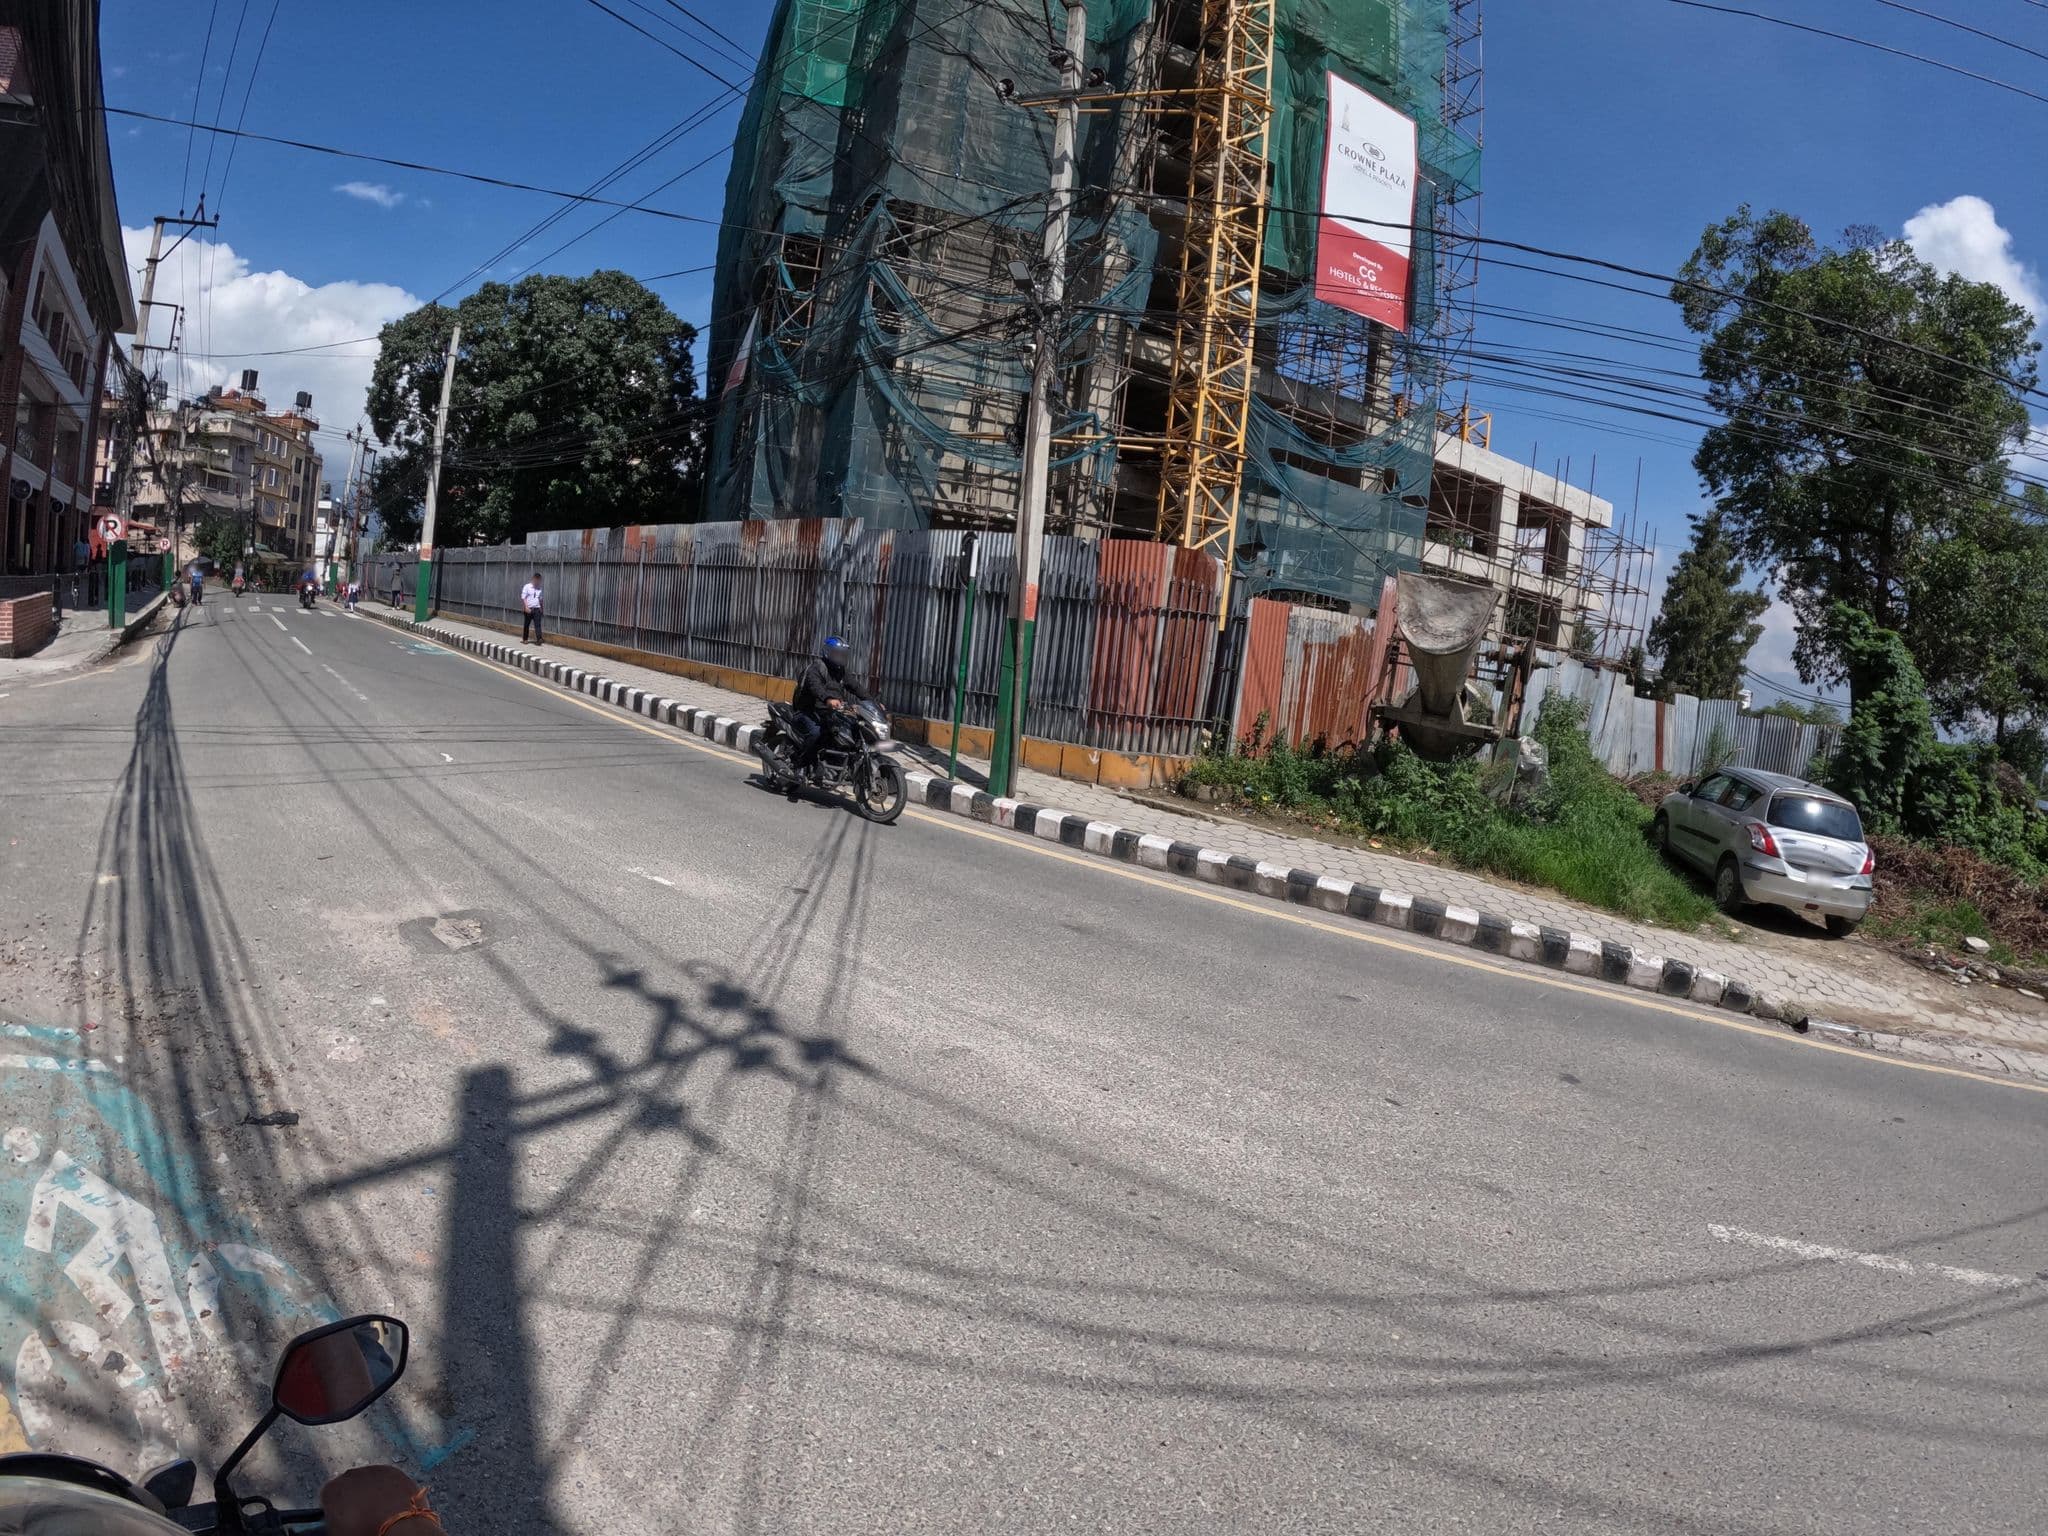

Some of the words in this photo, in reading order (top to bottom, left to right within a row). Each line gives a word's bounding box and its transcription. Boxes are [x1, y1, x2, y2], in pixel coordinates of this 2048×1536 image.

[1337, 143, 1377, 171] CROWNE
[1379, 166, 1407, 189] PLAZA
[1329, 265, 1362, 286] HOTELS
[1359, 265, 1377, 282] CG
